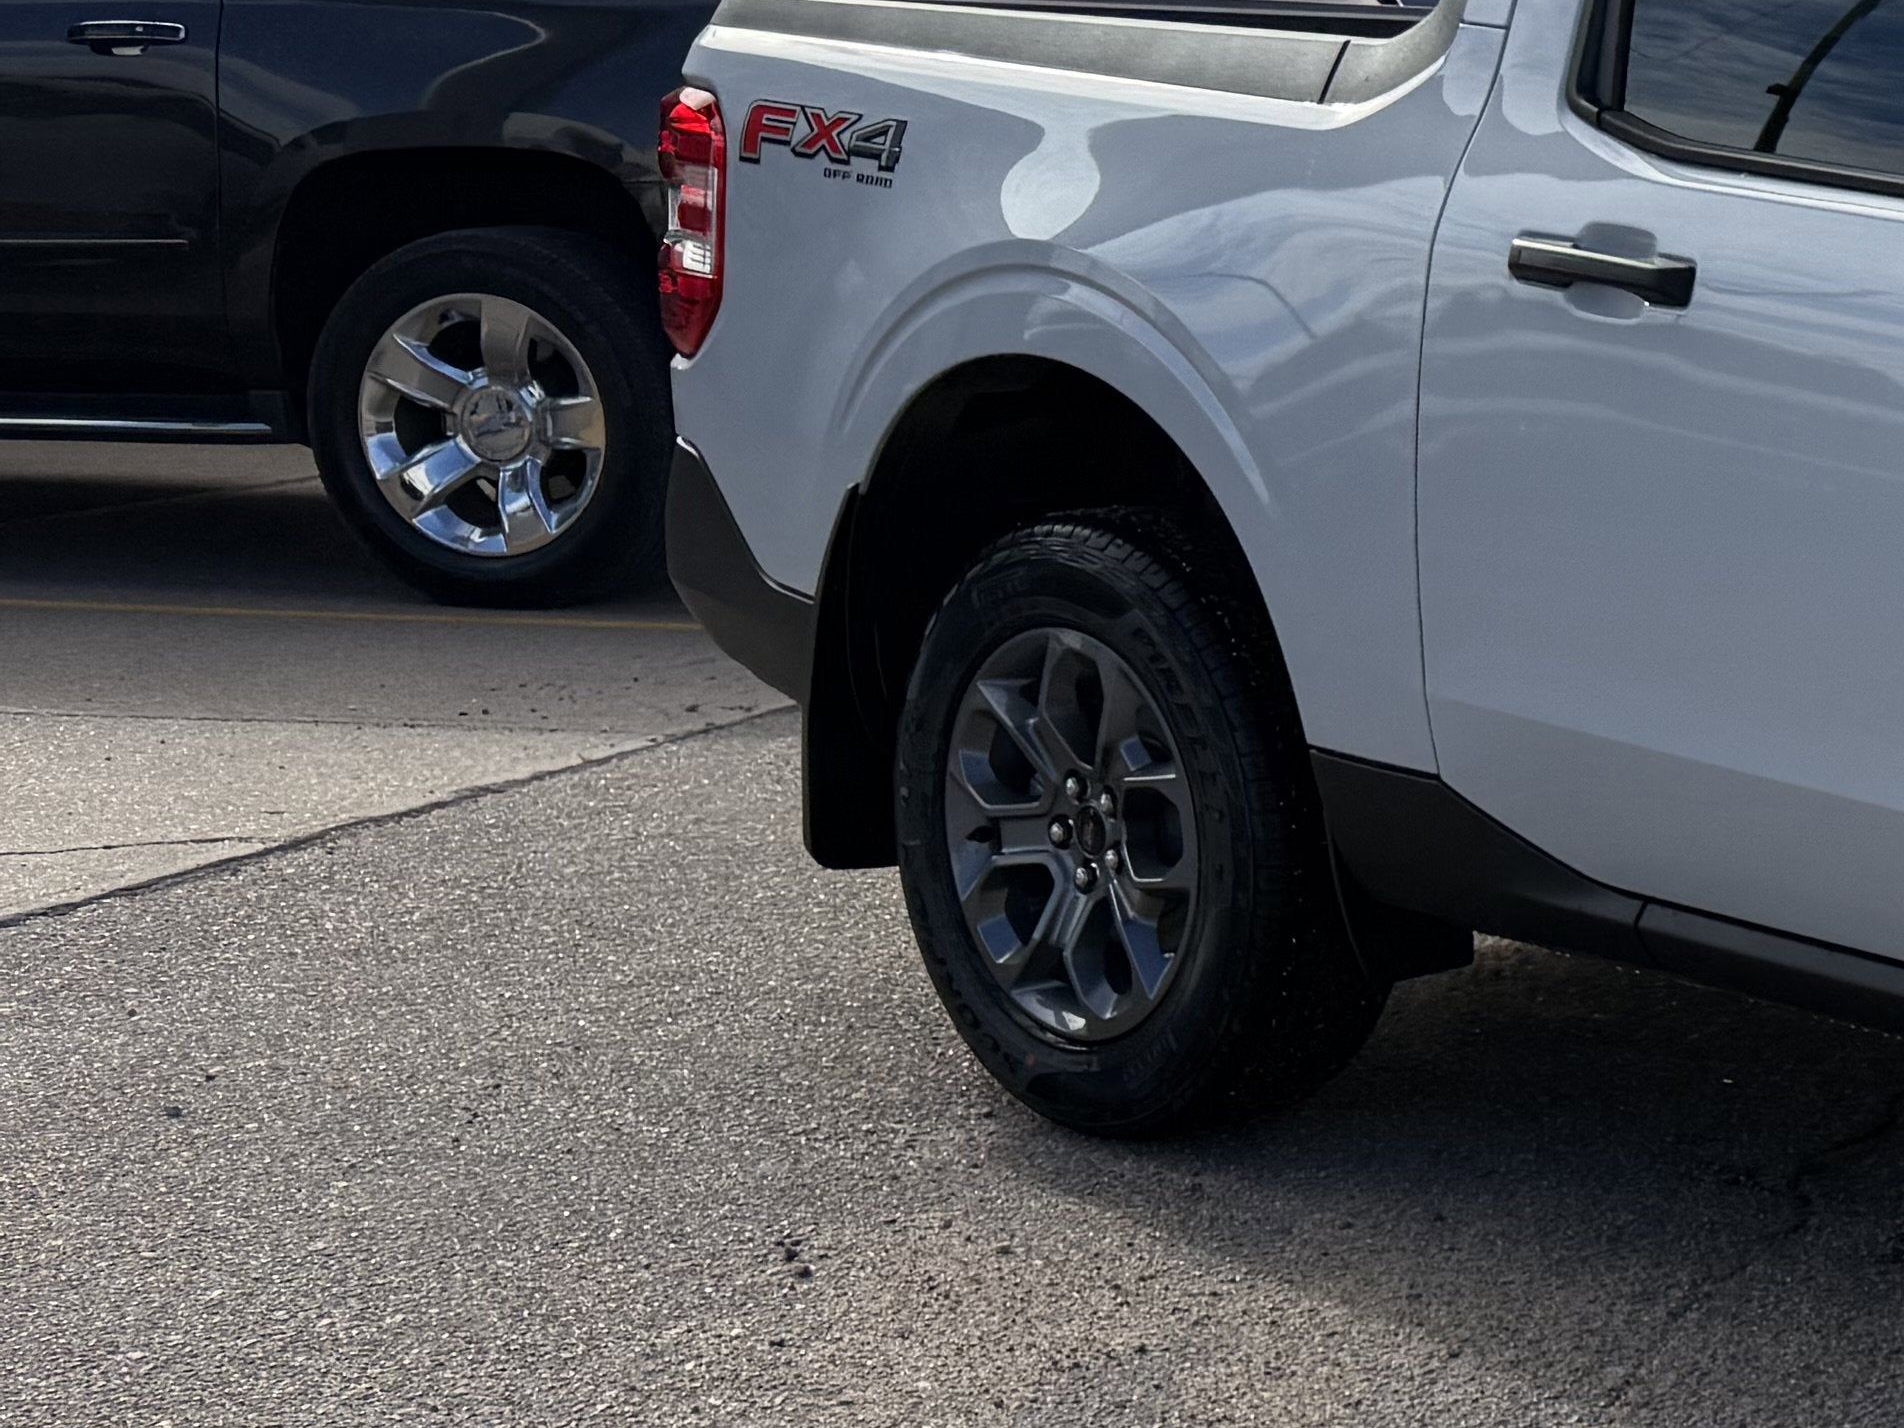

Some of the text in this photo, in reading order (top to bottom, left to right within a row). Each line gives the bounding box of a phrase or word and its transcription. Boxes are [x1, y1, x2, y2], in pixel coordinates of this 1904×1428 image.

[739, 98, 908, 172] FX4
[823, 167, 893, 189] OFF ROAD
